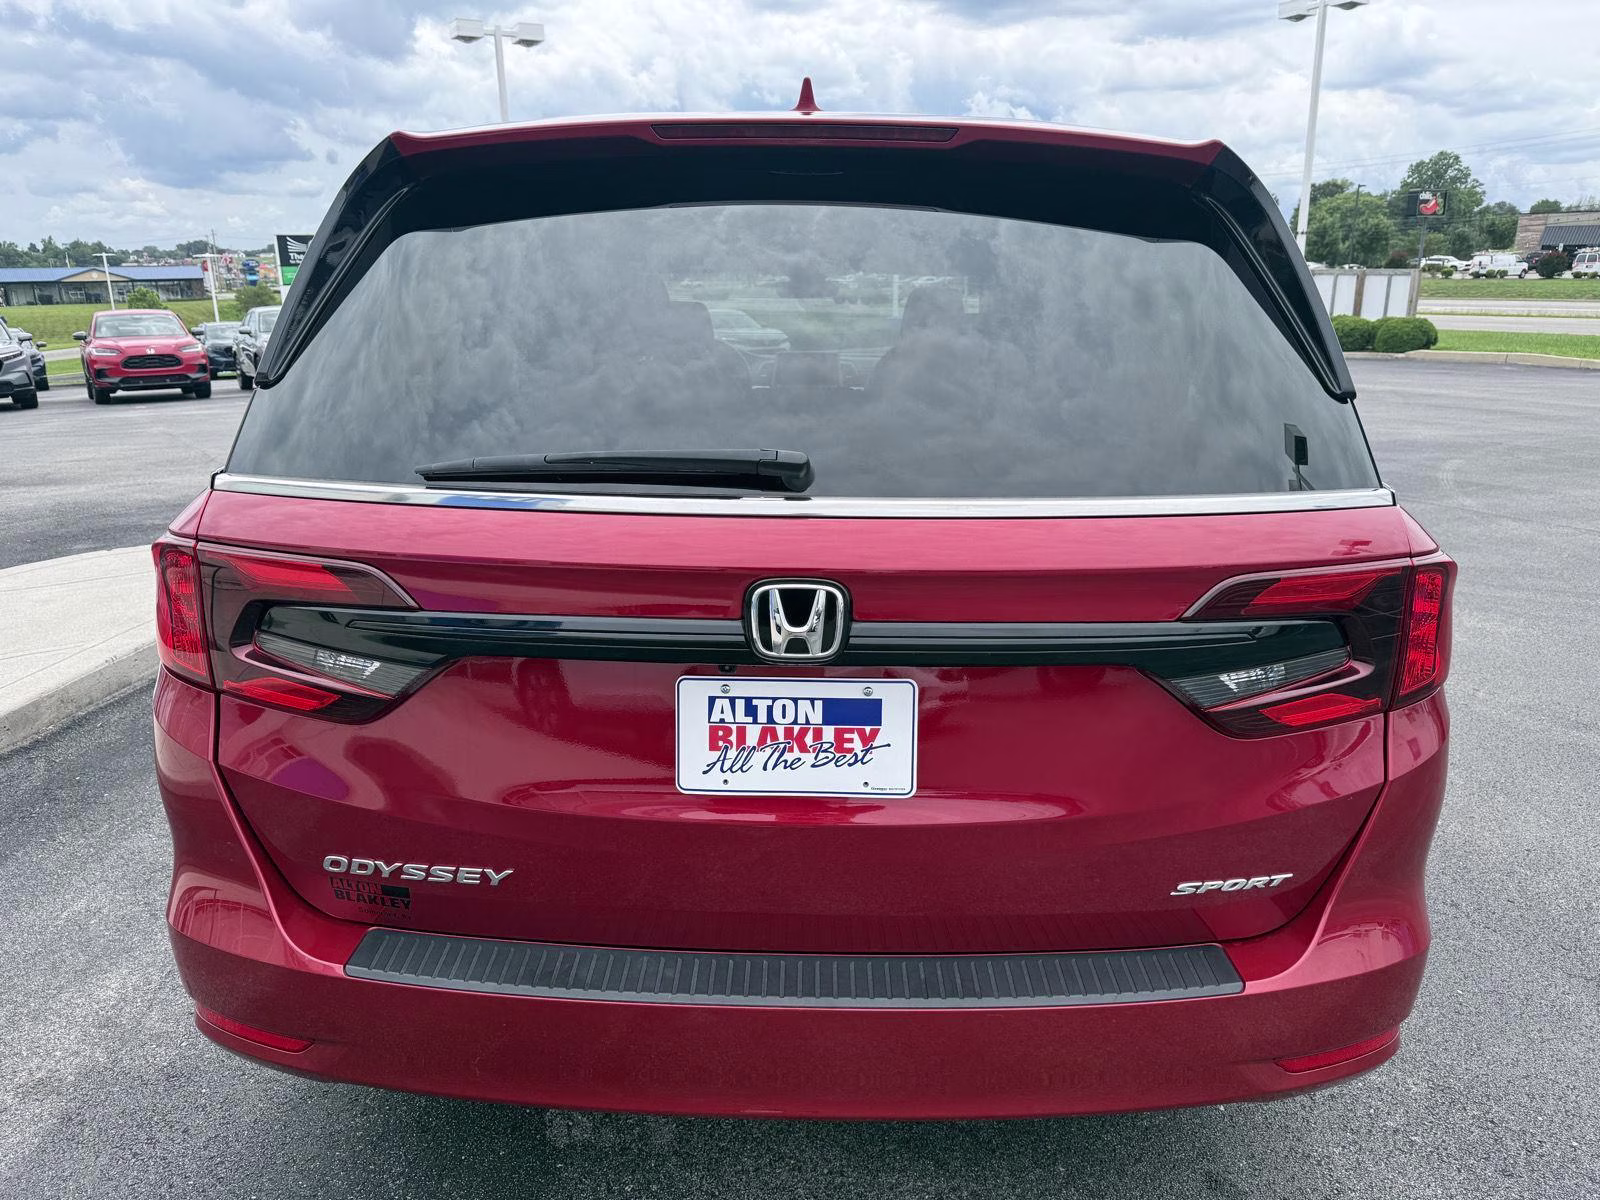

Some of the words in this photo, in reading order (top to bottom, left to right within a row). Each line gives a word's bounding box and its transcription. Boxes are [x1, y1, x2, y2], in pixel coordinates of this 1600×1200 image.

[709, 698, 823, 725] ALTON
[708, 725, 881, 754] BLAKLEY
[702, 745, 757, 775] All
[760, 741, 806, 772] The
[808, 741, 891, 769] Best
[322, 855, 514, 886] ODYSSEY
[330, 876, 382, 895] ALTON
[1170, 873, 1294, 896] SPORT
[334, 888, 411, 910] BLAKLEY
